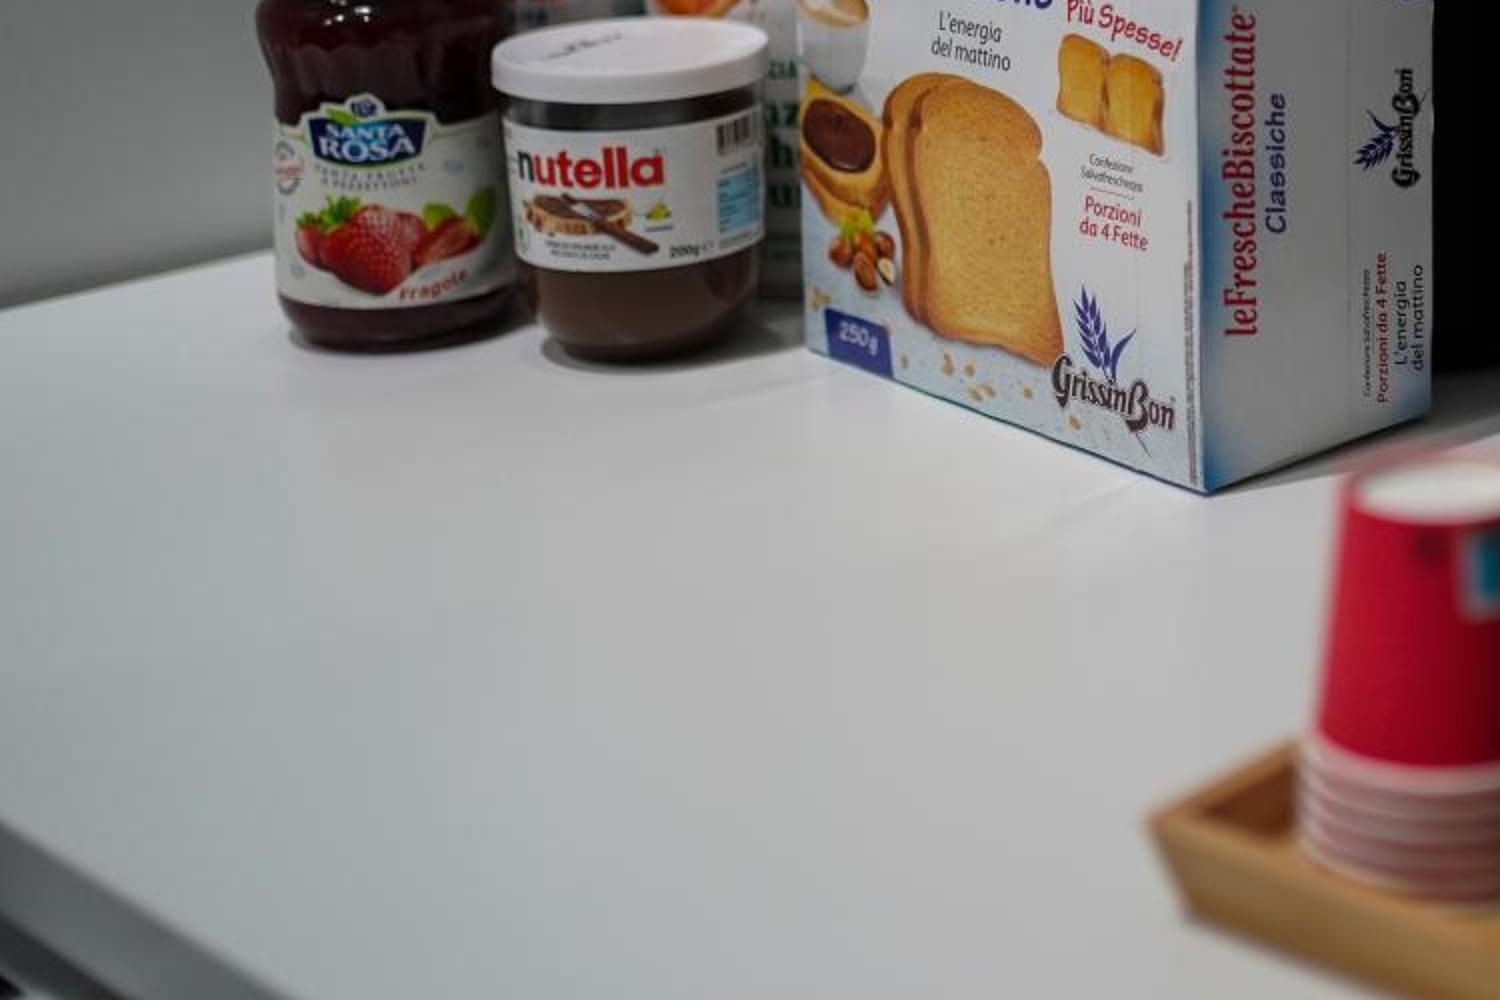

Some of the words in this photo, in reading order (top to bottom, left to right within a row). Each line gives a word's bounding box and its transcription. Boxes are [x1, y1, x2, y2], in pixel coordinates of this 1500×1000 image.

[939, 10, 1002, 45] L'energia
[1099, 4, 1183, 62] Spesse!
[931, 36, 953, 57] del
[955, 41, 1011, 71] mattino
[319, 135, 417, 162] ROSA
[325, 122, 406, 139] SANTA
[517, 147, 664, 188] nutella
[1222, 11, 1258, 337] leFrescheBiscottate
[1264, 92, 1287, 234] Classiche
[1085, 195, 1142, 228] Porzioni
[1079, 216, 1098, 237] da
[1113, 225, 1149, 252] Fette
[1376, 252, 1388, 294] Fette
[1376, 298, 1388, 309] 4
[1412, 265, 1424, 338] mattino
[1376, 313, 1388, 333] da
[1394, 281, 1410, 365] L'energia
[1376, 337, 1389, 403] Porzioni
[1410, 344, 1424, 371] del
[1053, 354, 1176, 433] GrissinBon
